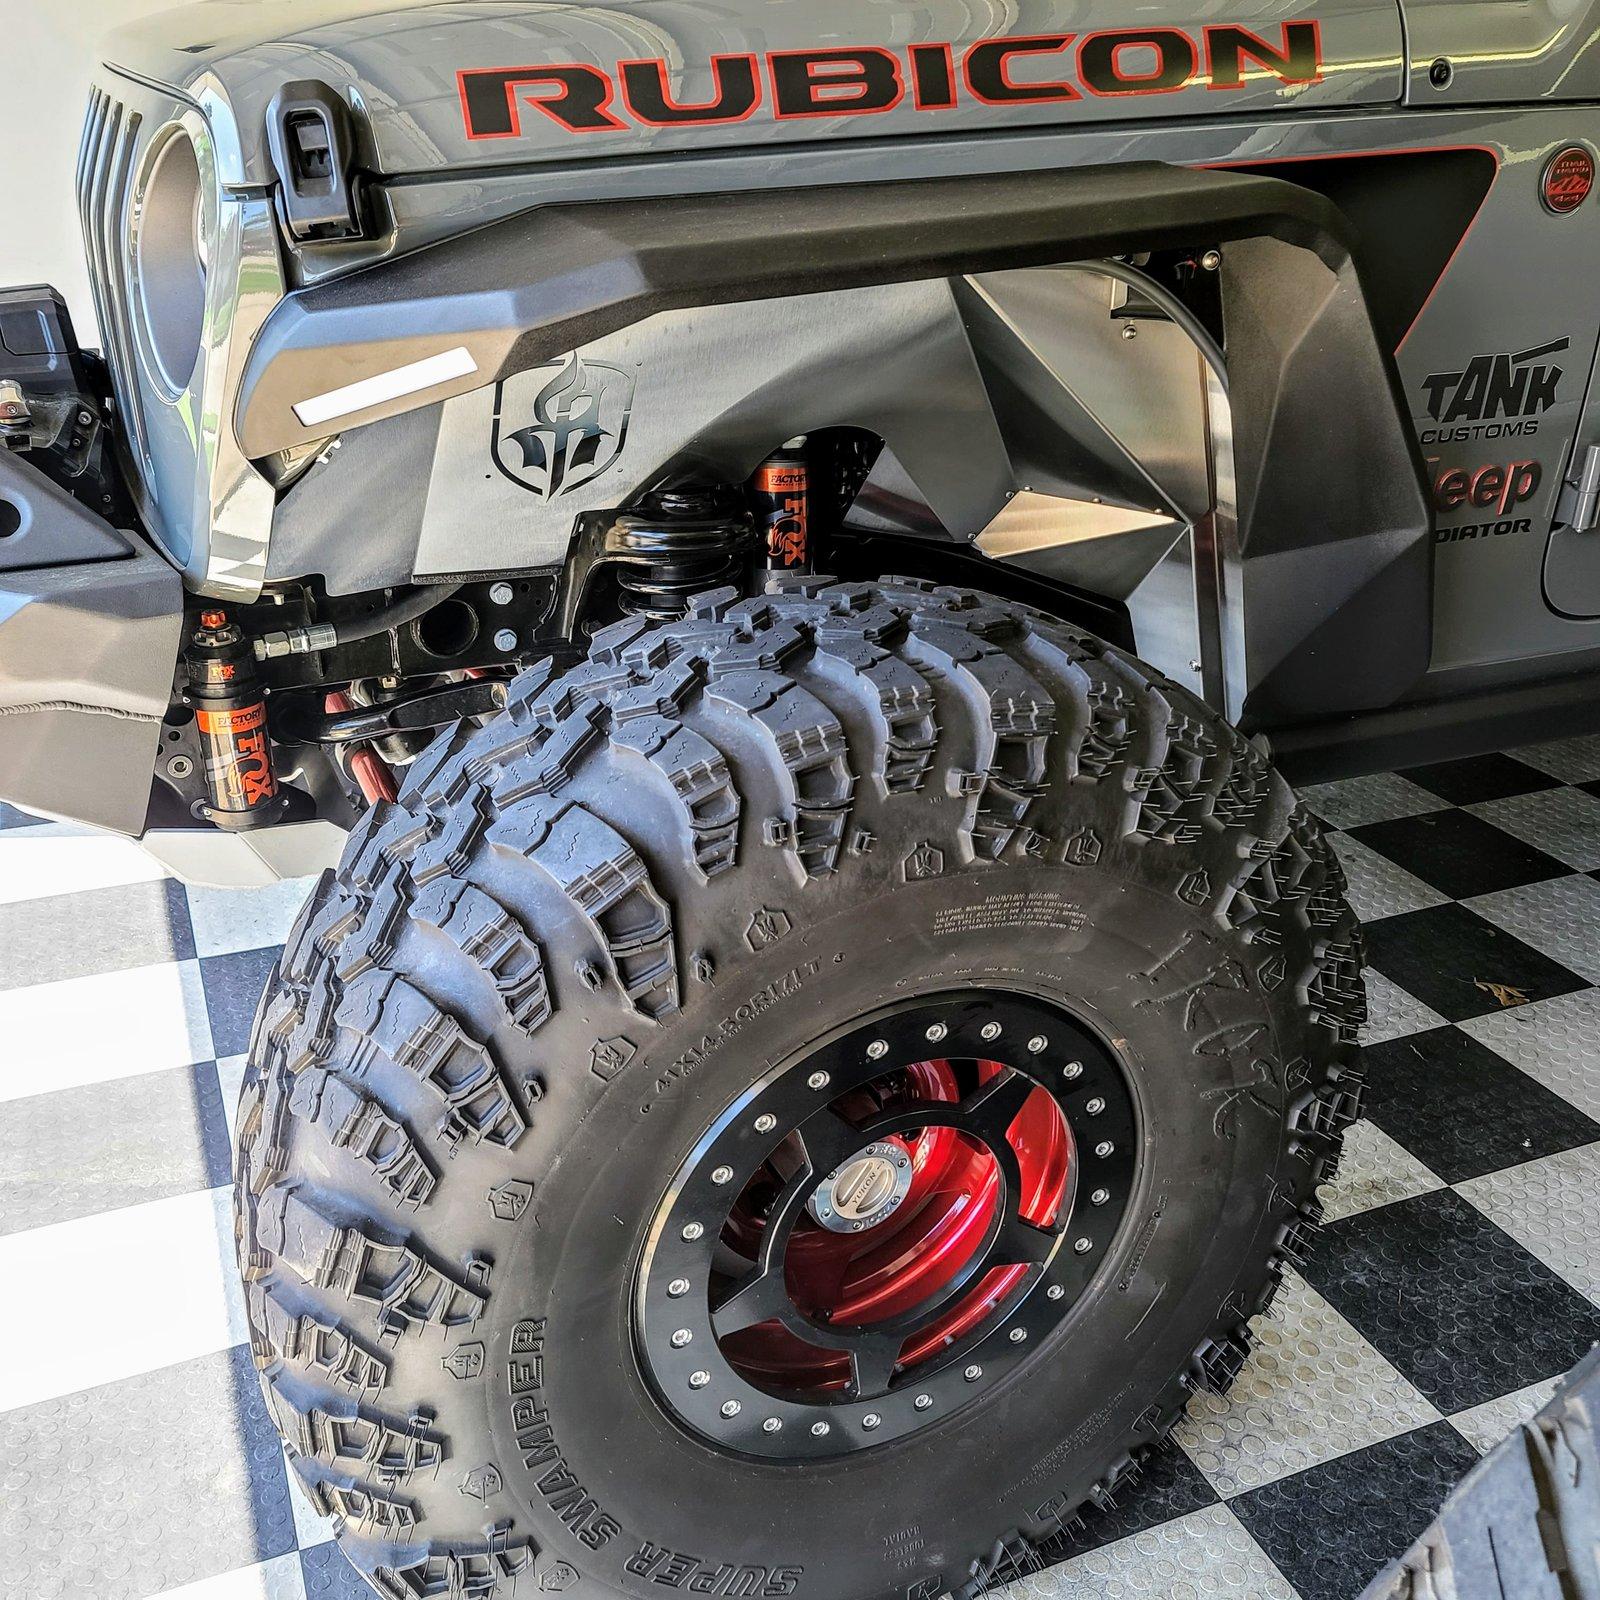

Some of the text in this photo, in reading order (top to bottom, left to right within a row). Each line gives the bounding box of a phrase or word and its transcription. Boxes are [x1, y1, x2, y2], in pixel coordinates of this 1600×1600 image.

[456, 20, 1322, 140] RUBICON
[1420, 336, 1570, 424] TANK
[1420, 420, 1539, 445] CUSTOMS
[852, 1172, 877, 1204] YUKON
[508, 1317, 622, 1550] SWAMPER
[624, 1541, 804, 1596] SUPER
